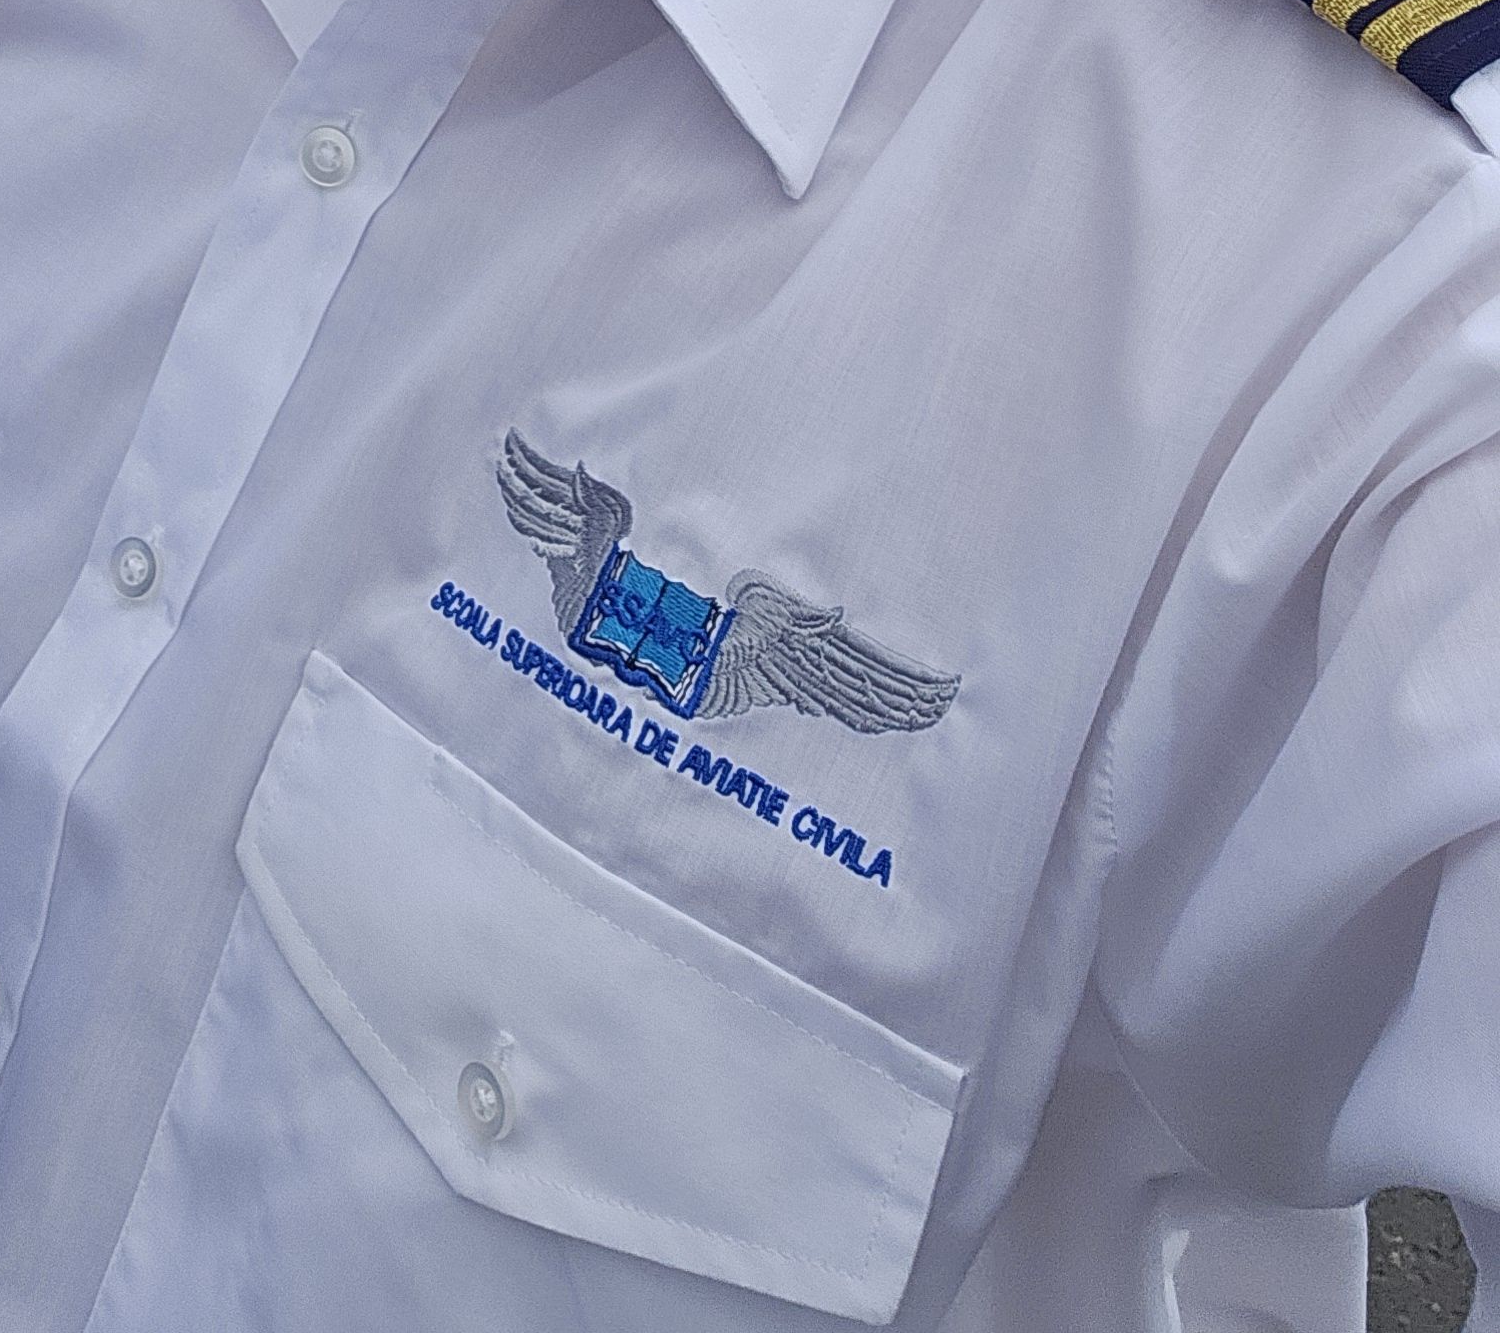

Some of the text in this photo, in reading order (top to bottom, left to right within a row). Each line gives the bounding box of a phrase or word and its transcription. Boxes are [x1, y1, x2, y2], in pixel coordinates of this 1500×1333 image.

[430, 581, 892, 888] SCOALA SUPERIOARA DE AVIATIE CIVILA
